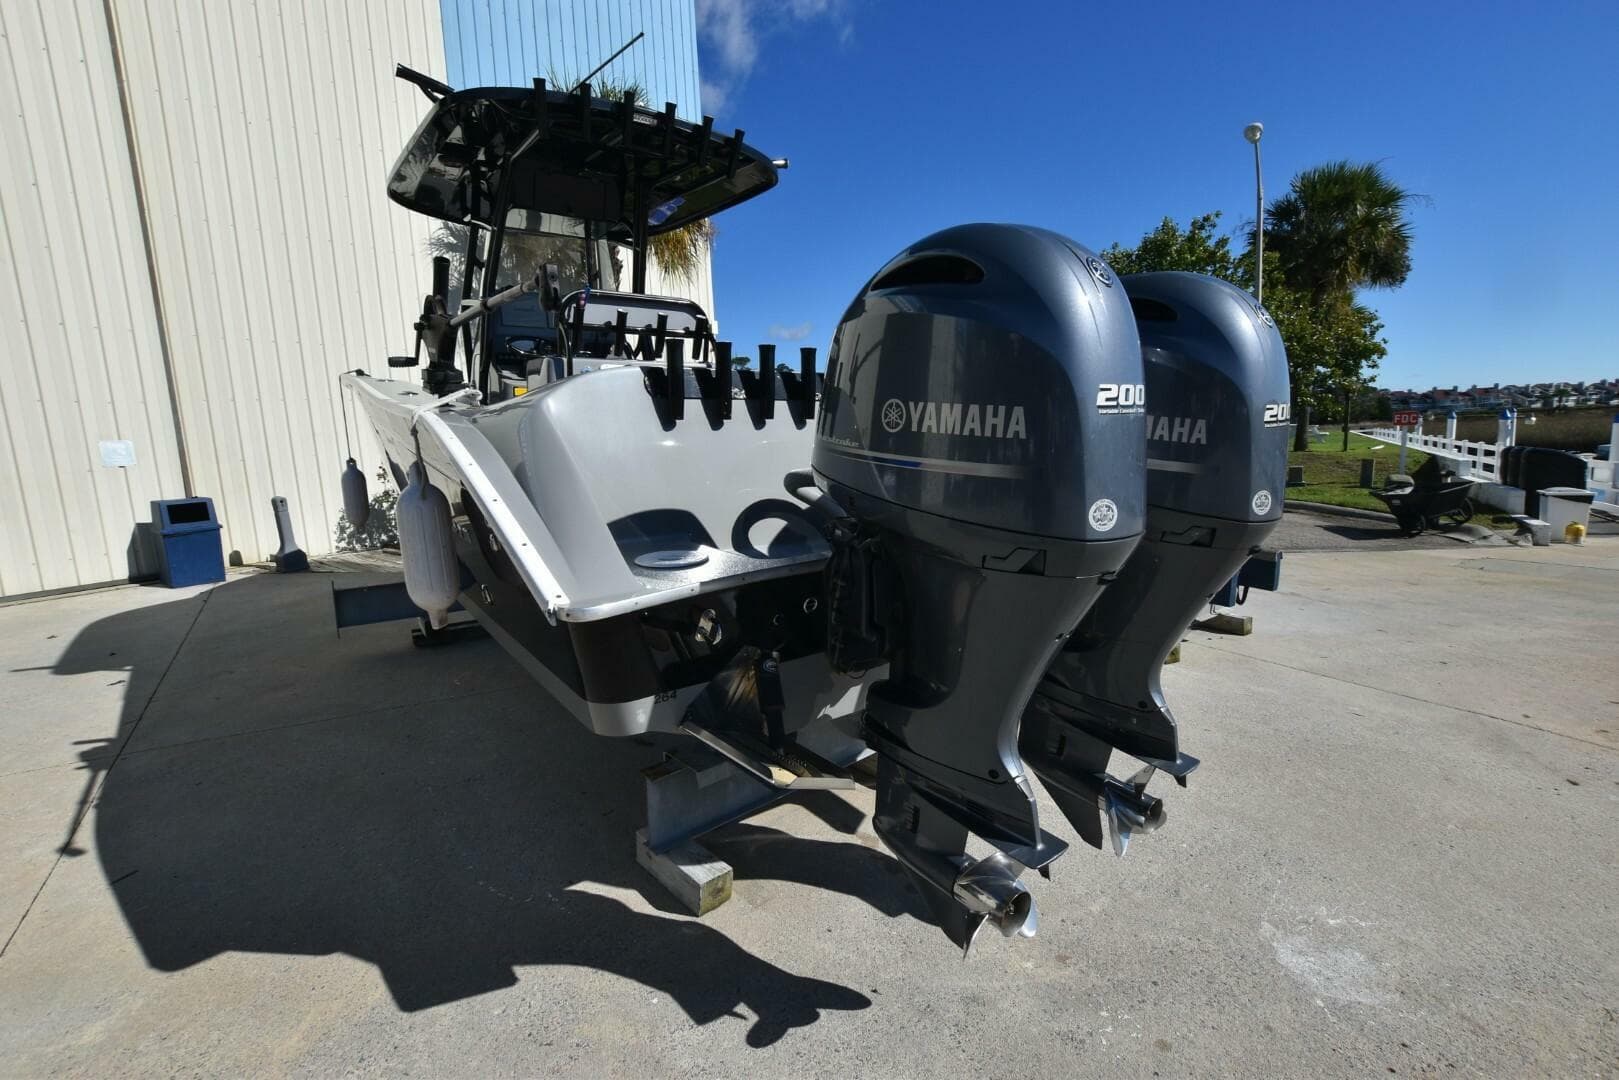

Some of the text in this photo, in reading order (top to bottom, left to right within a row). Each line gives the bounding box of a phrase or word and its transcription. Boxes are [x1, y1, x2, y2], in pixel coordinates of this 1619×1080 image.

[1096, 384, 1145, 406] 200
[908, 401, 1027, 440] YAMAHA
[1146, 415, 1207, 445] AHA
[1394, 414, 1417, 424] FDC
